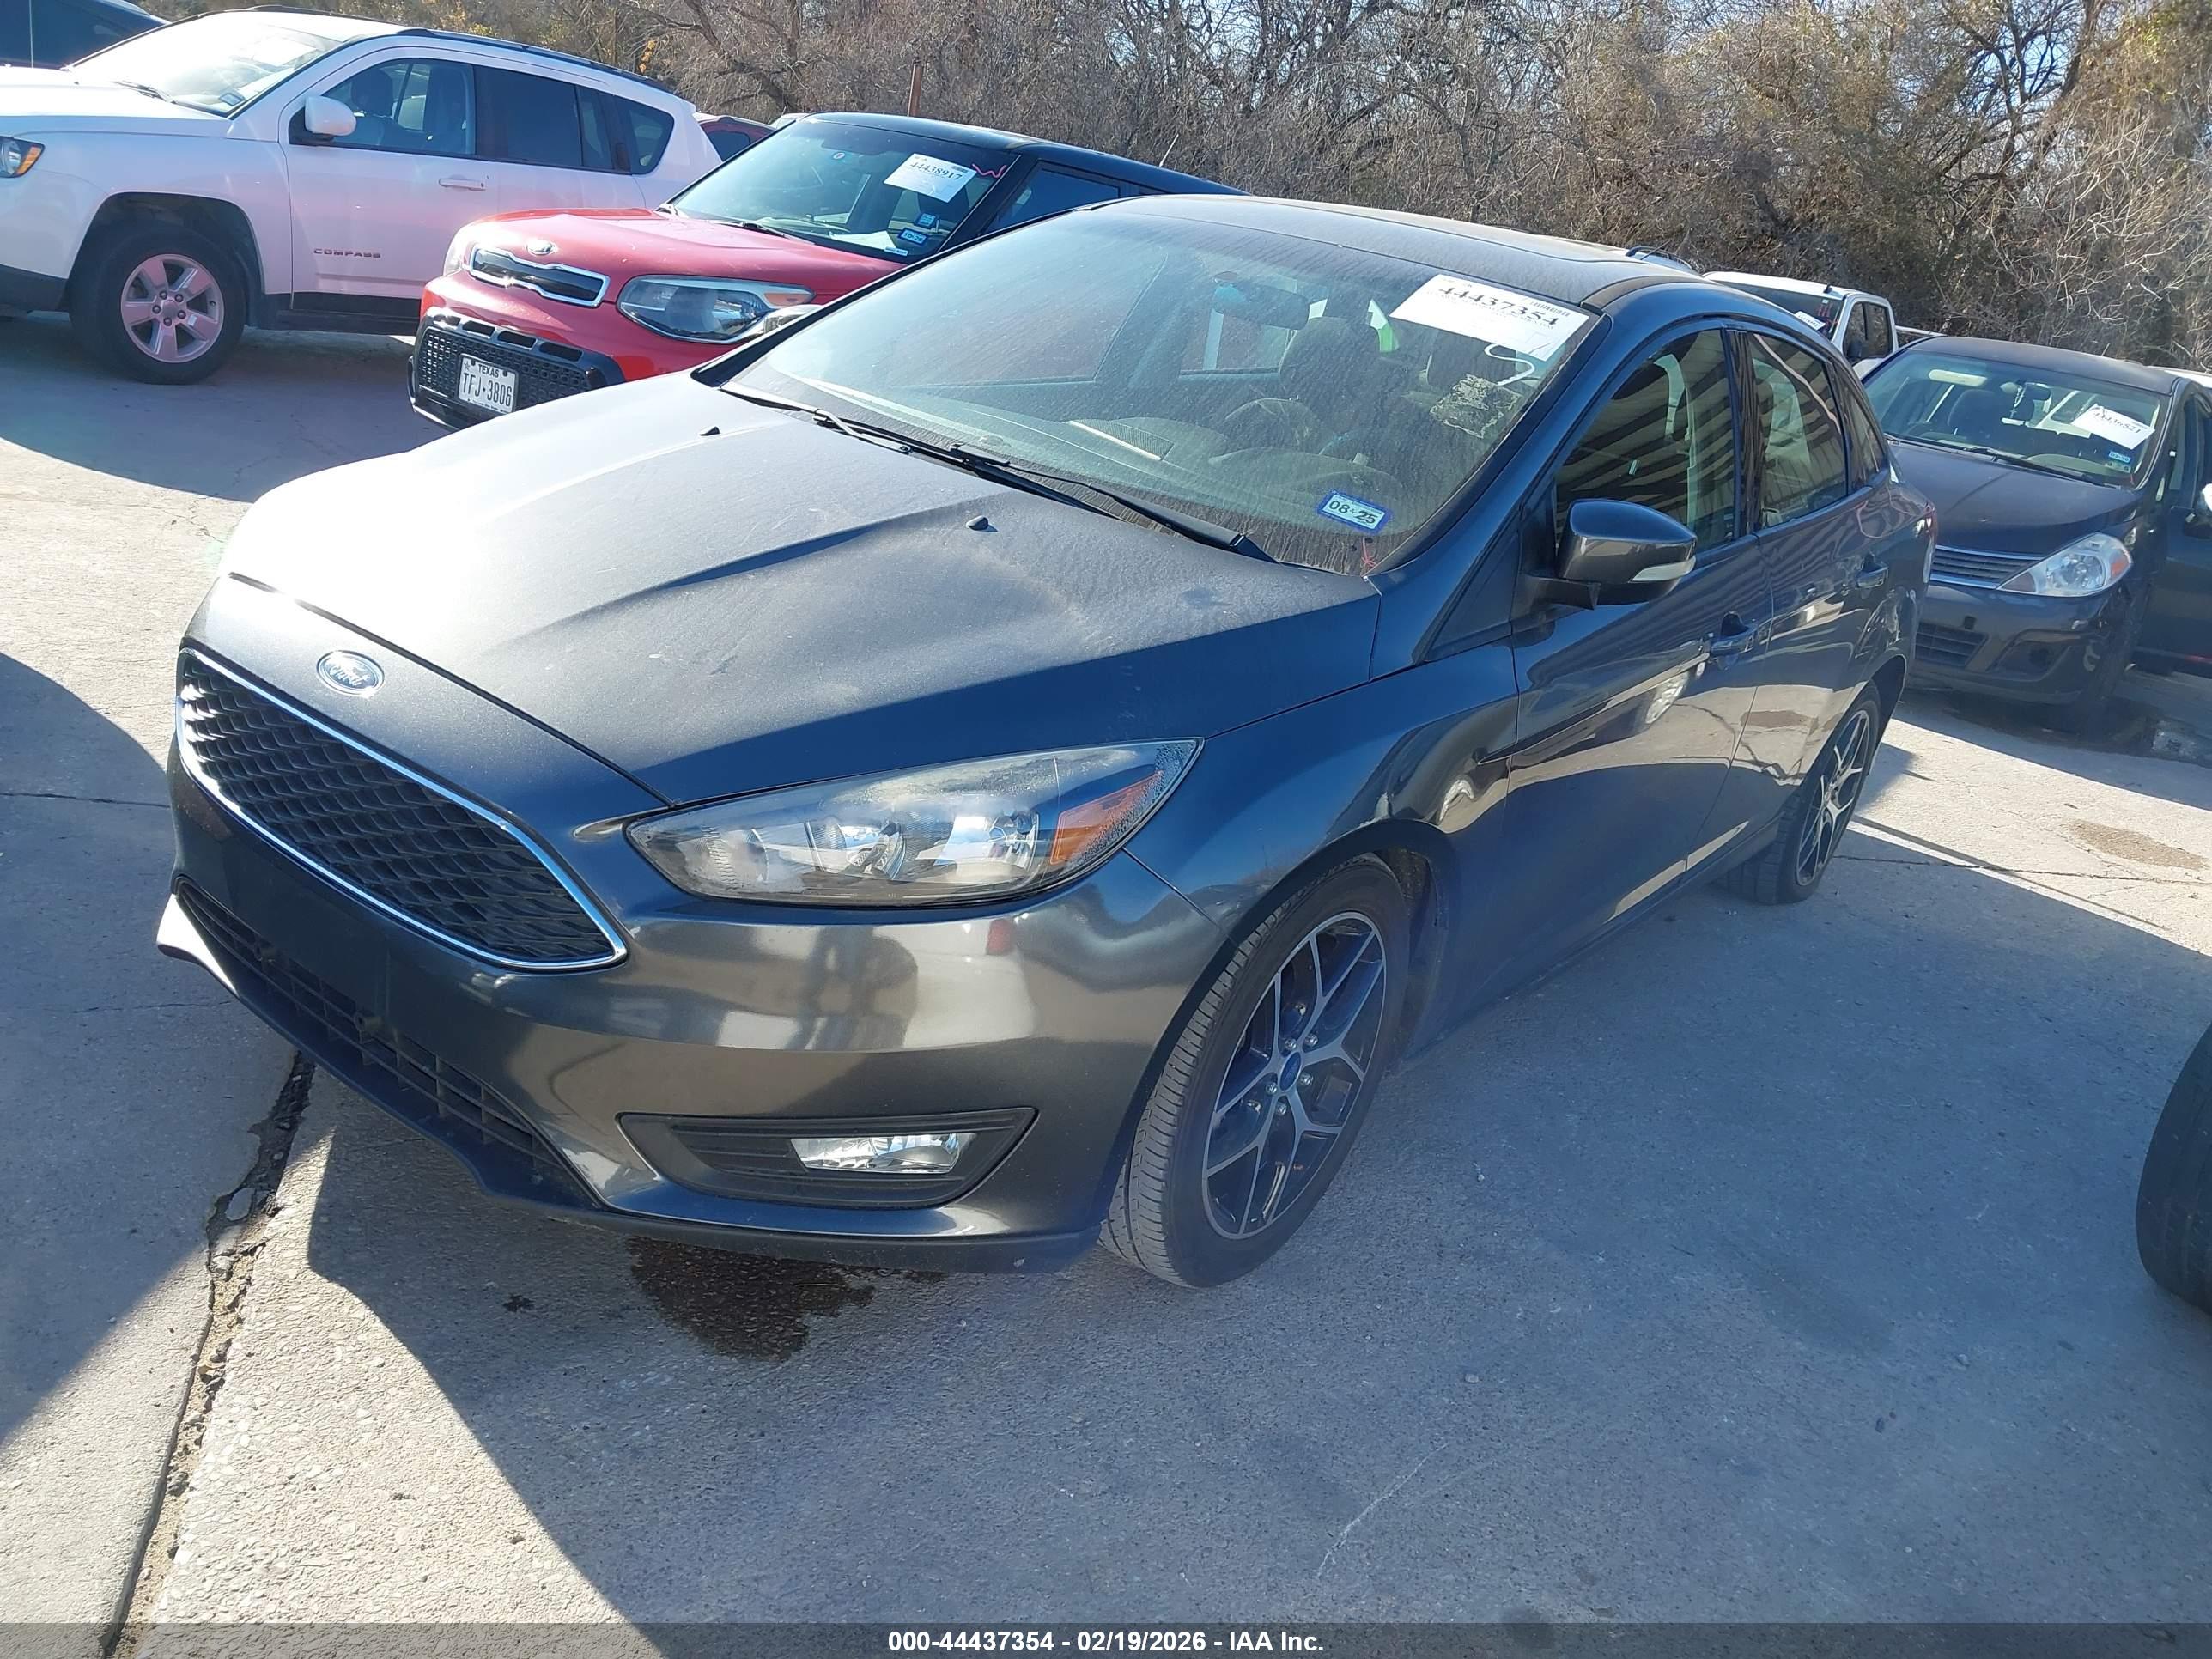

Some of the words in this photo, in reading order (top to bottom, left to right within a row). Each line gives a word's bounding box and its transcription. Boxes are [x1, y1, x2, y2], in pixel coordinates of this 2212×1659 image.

[910, 161, 963, 180] 44438917
[313, 248, 381, 258] COMPASS
[1438, 286, 1559, 326] 44437354
[477, 363, 500, 379] TEXAS
